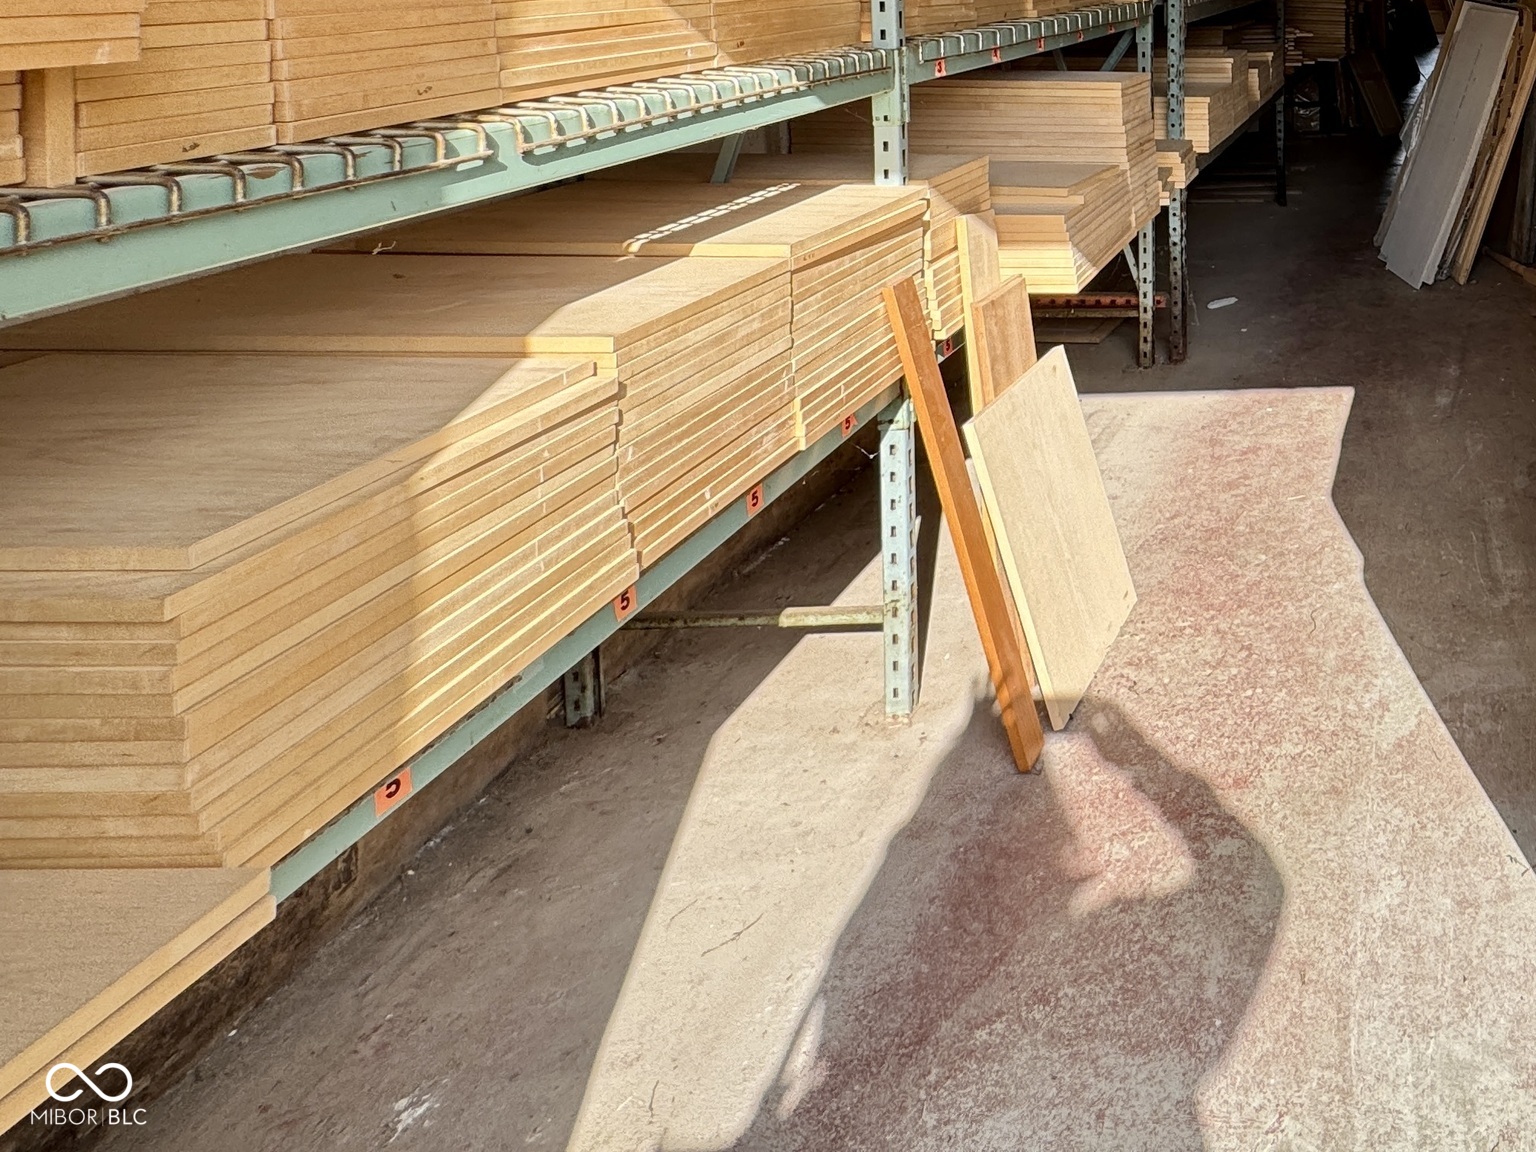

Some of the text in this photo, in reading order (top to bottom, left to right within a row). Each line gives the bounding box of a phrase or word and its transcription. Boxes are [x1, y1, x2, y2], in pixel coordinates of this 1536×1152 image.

[845, 416, 851, 430] 5
[751, 489, 759, 507] 5
[621, 589, 630, 610] 5
